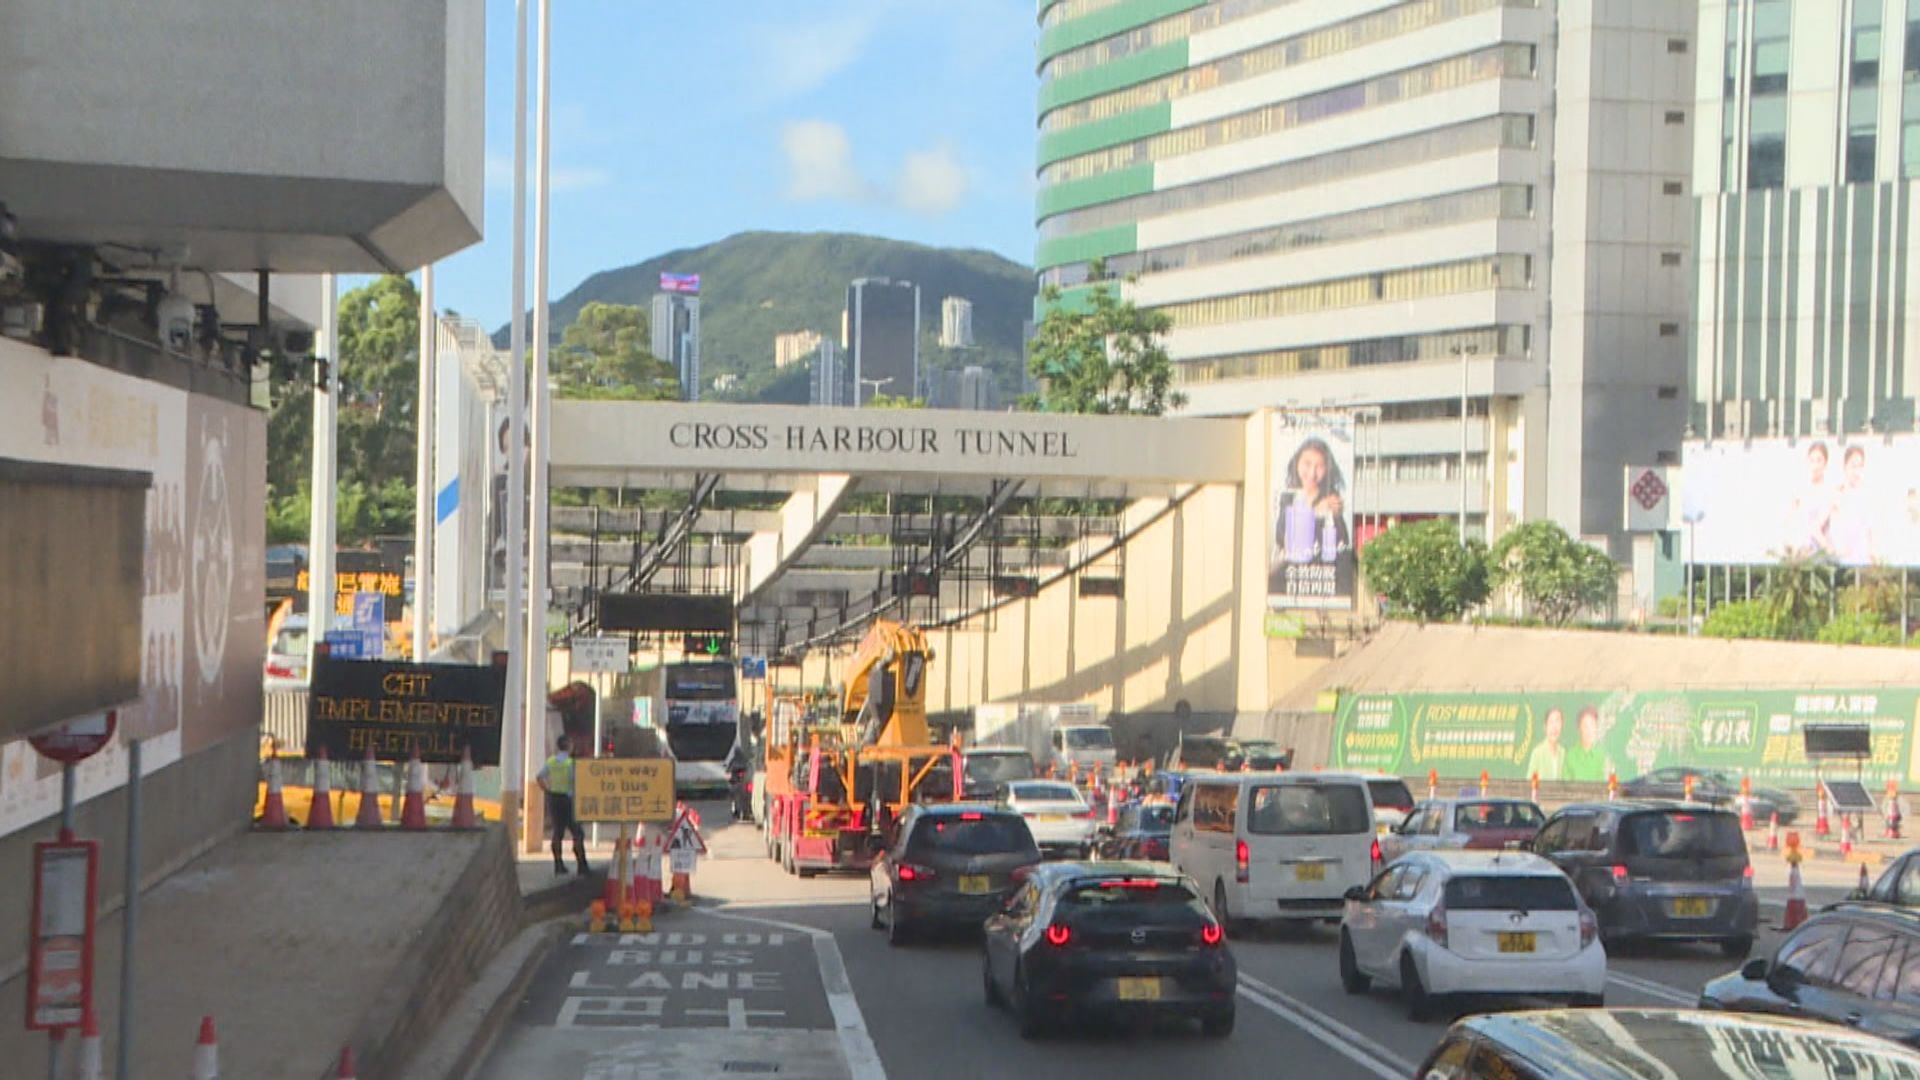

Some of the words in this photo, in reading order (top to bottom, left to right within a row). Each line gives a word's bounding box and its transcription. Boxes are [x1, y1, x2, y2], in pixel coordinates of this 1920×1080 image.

[954, 429, 1079, 458] TUNNEL
[383, 672, 432, 695] CHT
[318, 696, 497, 727] IMPLEMENTED
[590, 763, 624, 776] Give
[629, 765, 658, 777] way
[601, 780, 616, 792] to
[621, 781, 649, 792] bus
[580, 796, 666, 816] 請讓巴士
[606, 950, 754, 966] BUS
[567, 971, 785, 991] LANE
